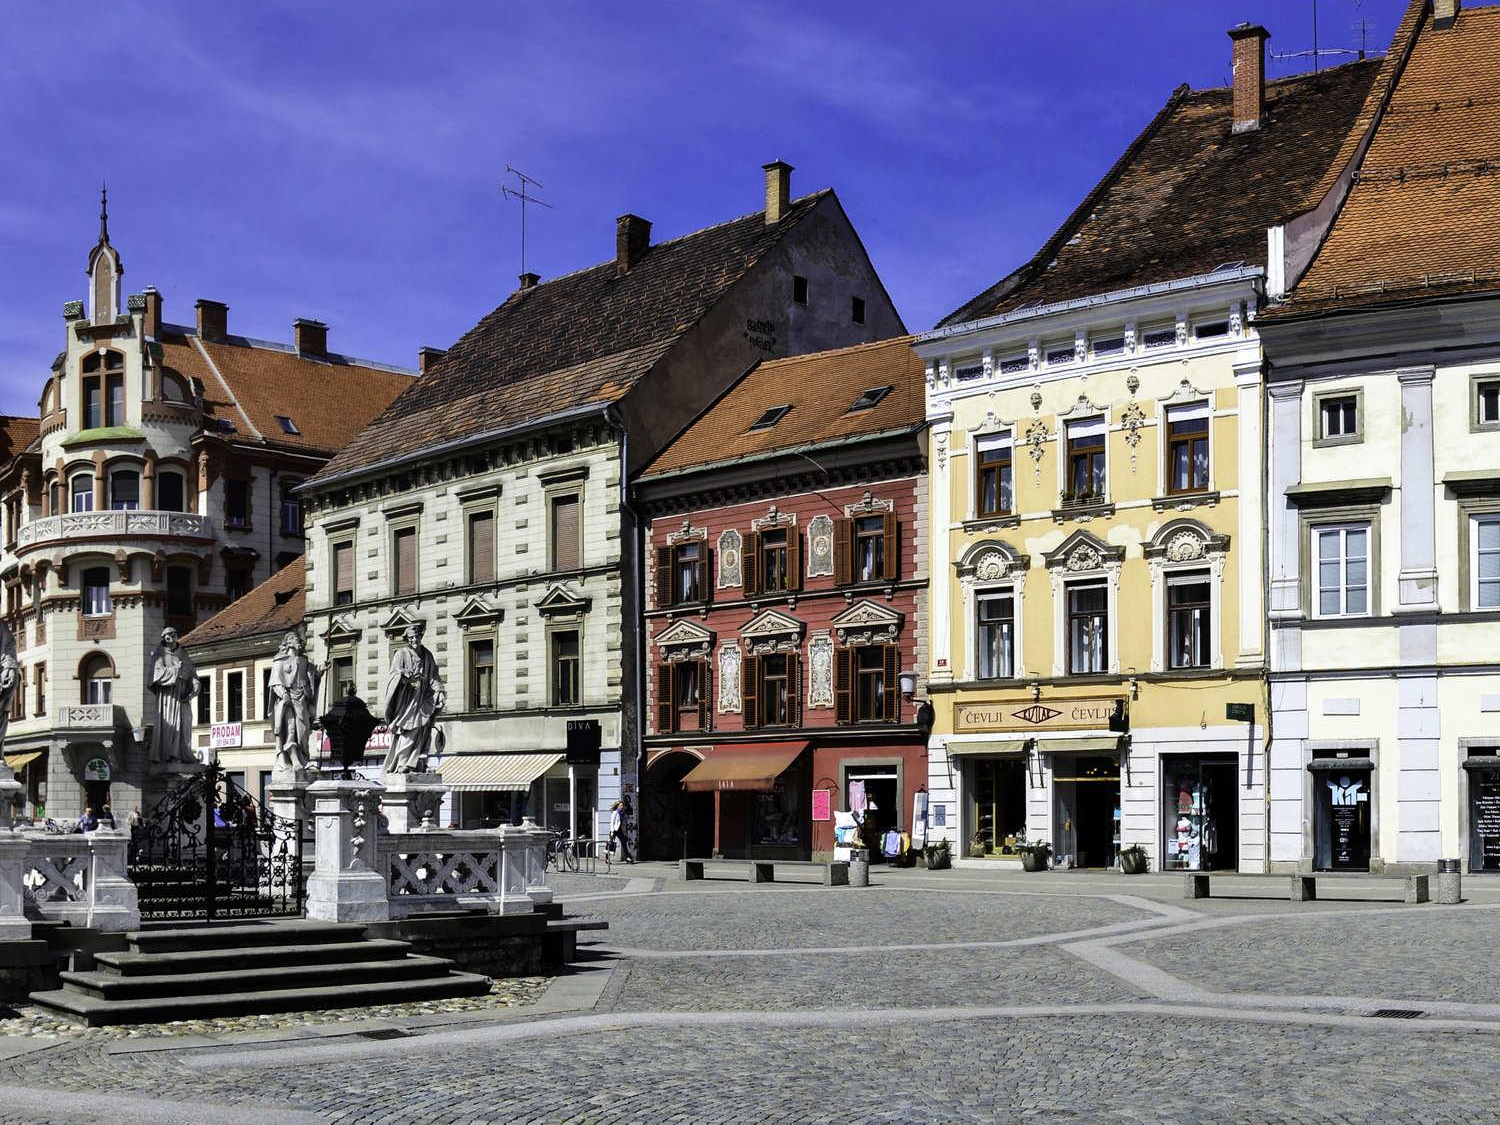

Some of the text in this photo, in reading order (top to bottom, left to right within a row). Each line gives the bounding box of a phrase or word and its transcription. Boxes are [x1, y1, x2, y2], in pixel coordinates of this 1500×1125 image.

[966, 712, 1003, 724] ČEVLJI
[1071, 707, 1111, 721] ČEVLJI
[212, 725, 241, 738] PRODAM
[568, 722, 591, 731] DIVA
